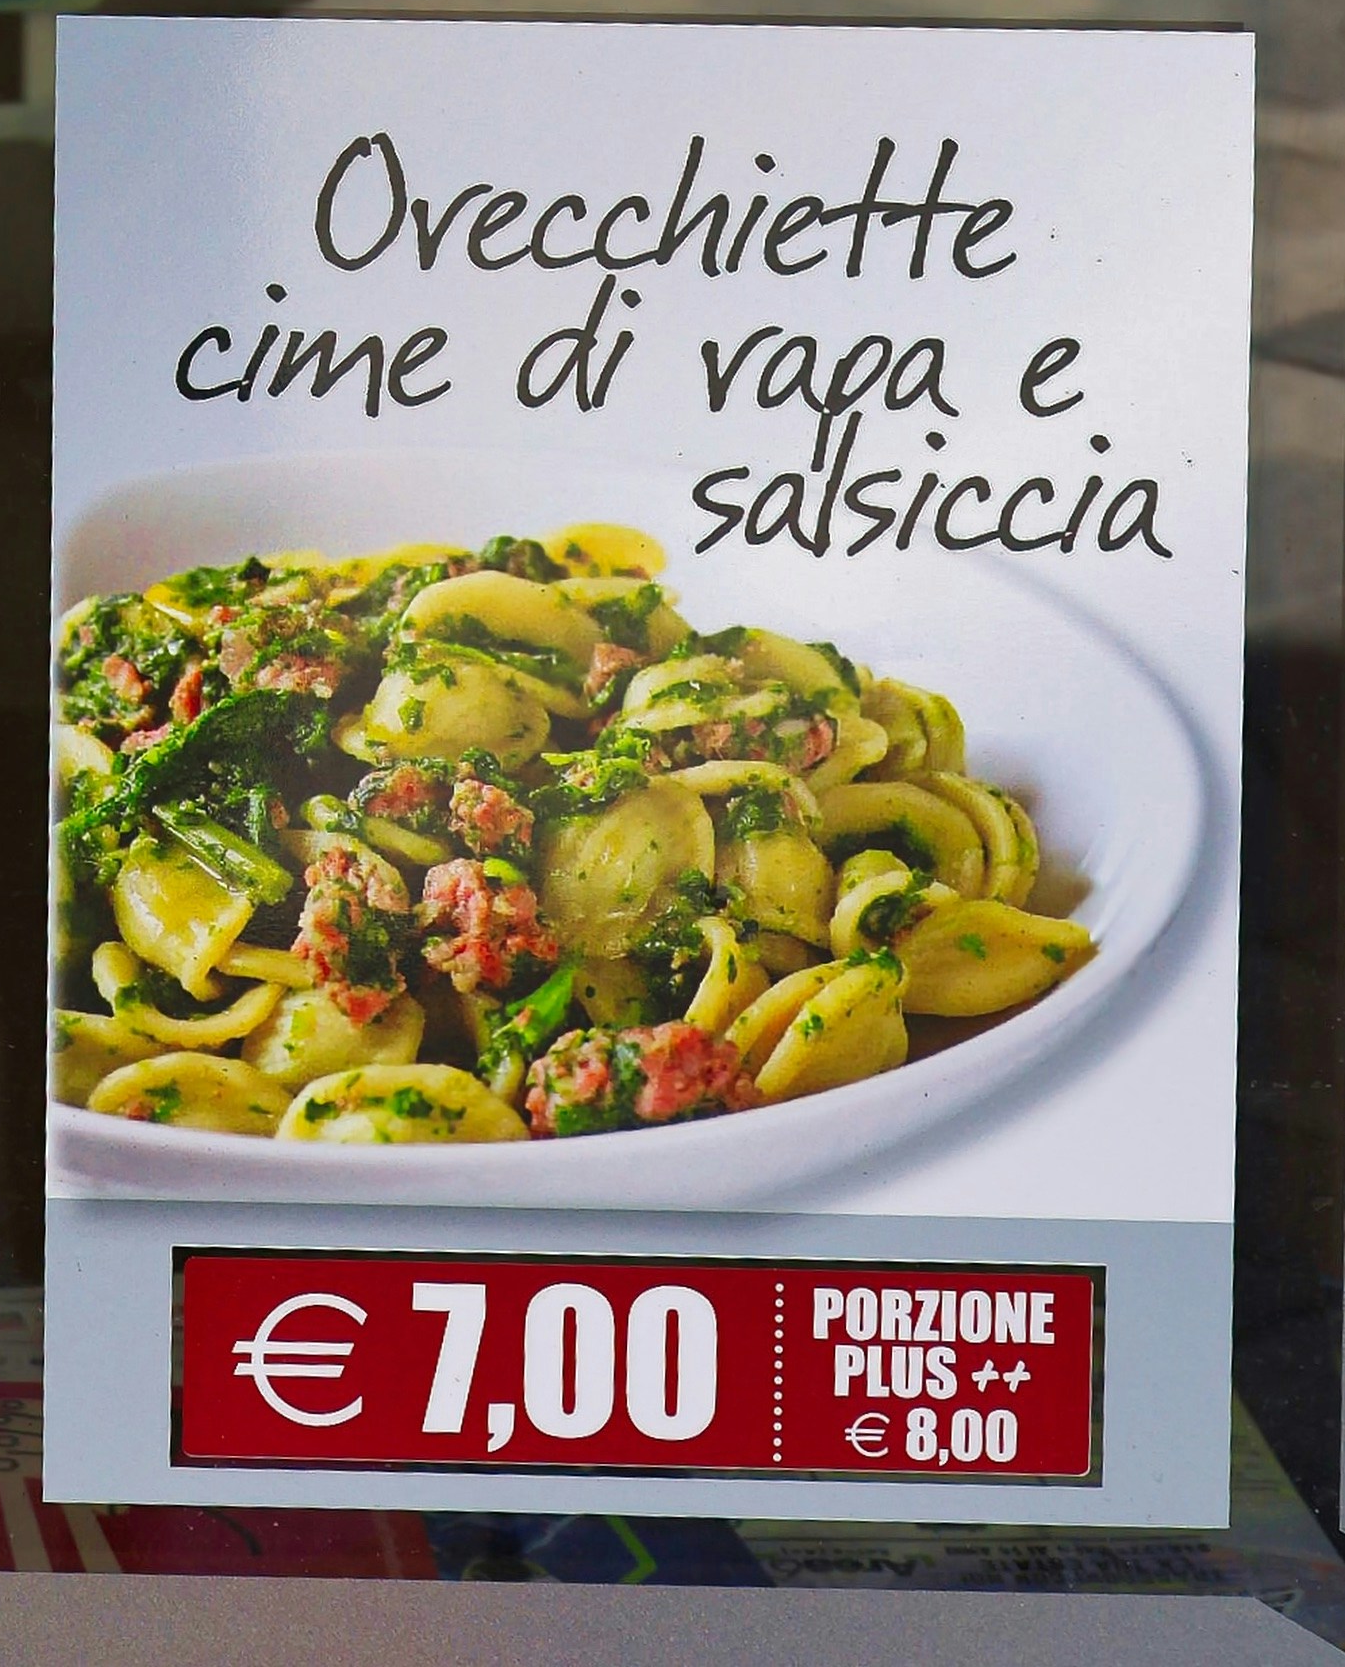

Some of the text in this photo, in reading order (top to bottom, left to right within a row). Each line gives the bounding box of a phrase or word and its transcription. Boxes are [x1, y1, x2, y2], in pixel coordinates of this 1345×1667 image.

[315, 133, 1016, 279] Orecchiette
[176, 275, 1083, 473] cime di rapa e
[692, 411, 1174, 559] salsiccia
[232, 1283, 717, 1452] € 7,00
[814, 1288, 1054, 1344] PORZIONE
[835, 1345, 1030, 1399] PLUS ++
[845, 1408, 1017, 1466] € 8,00
